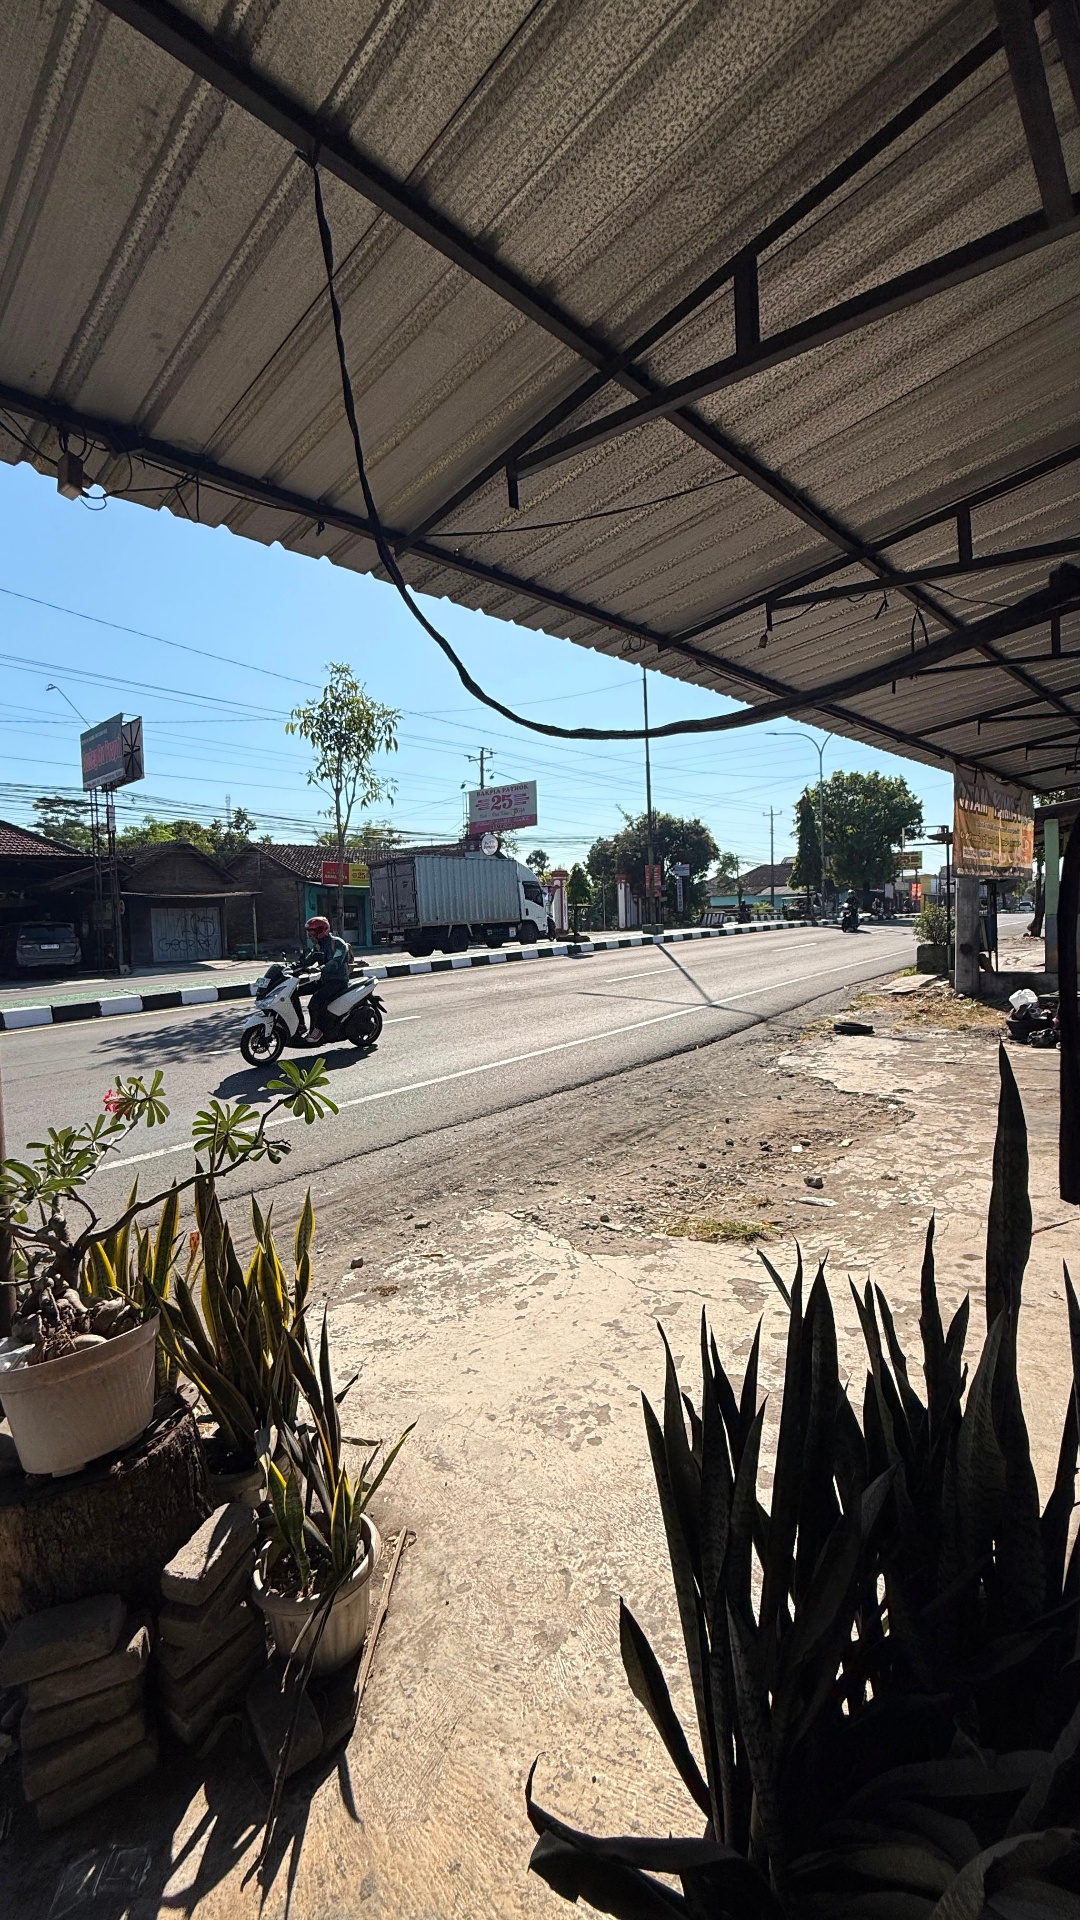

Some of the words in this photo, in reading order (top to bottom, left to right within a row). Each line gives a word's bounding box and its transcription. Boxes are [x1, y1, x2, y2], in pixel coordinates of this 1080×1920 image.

[476, 789, 501, 797] BAKPIA
[502, 784, 529, 794] PATHOK
[491, 794, 513, 811] 25
